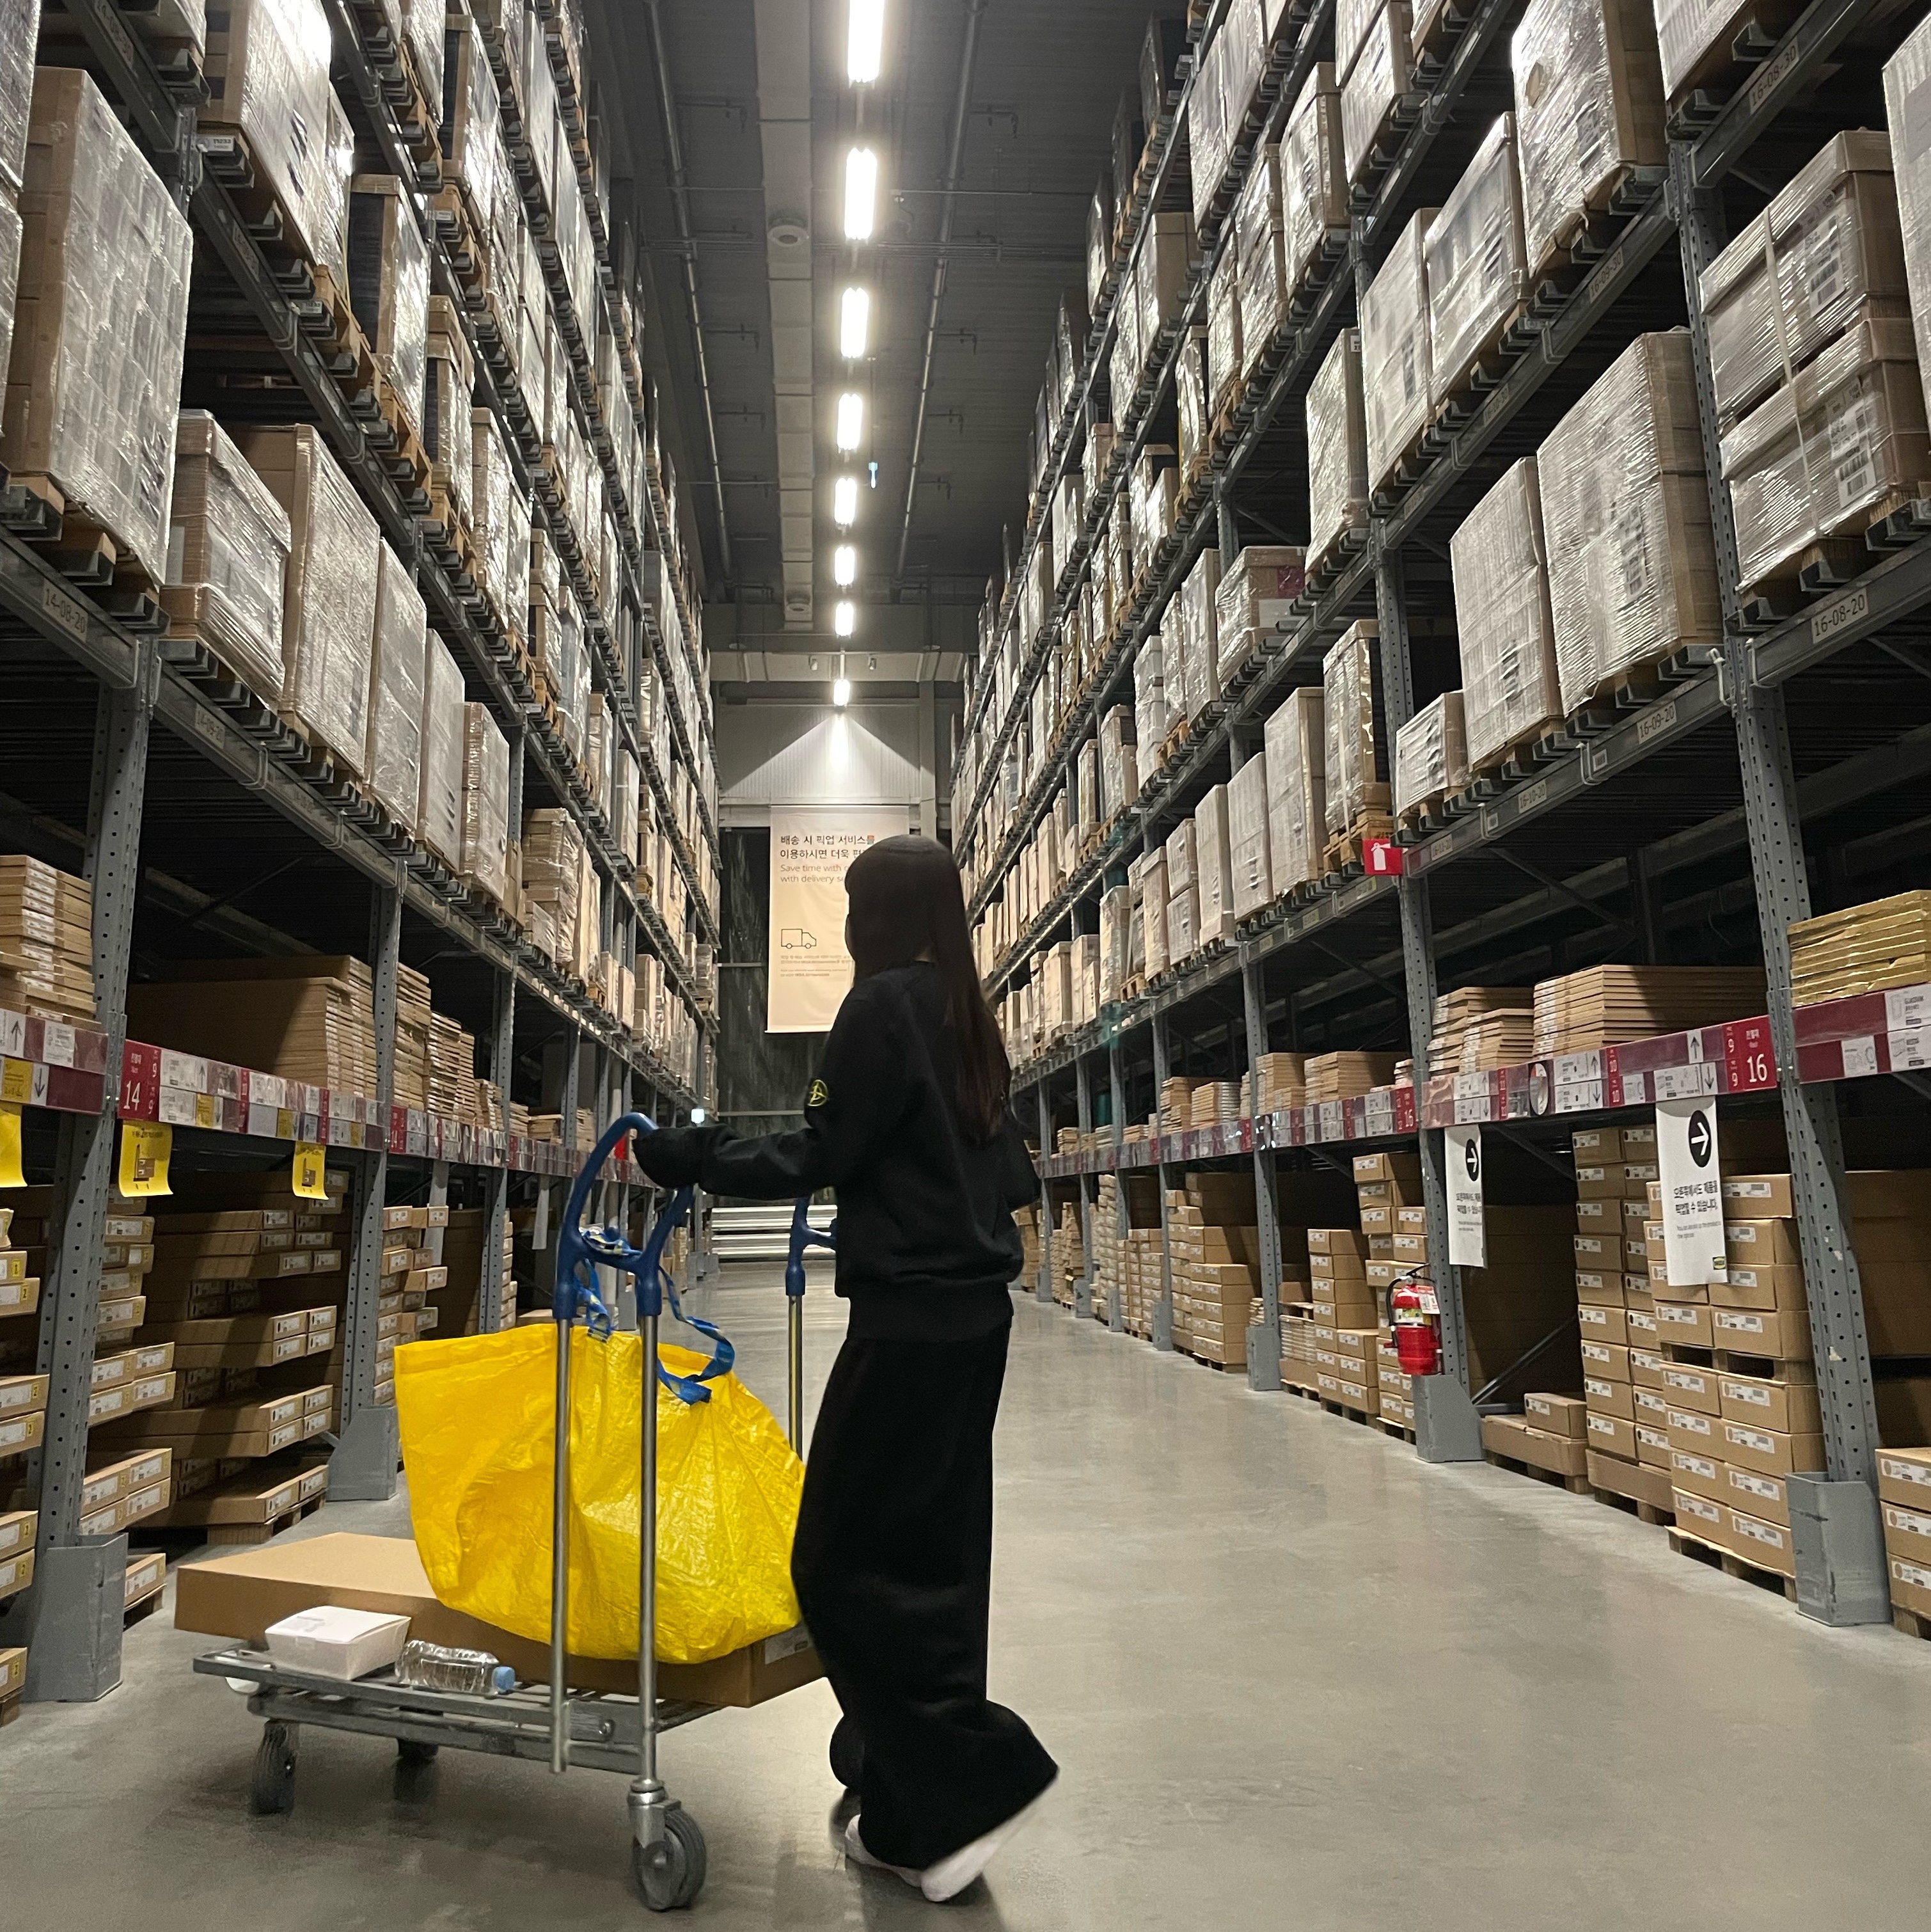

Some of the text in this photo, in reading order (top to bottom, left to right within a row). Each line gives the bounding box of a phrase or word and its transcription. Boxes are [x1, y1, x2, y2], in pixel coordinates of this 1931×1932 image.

[1752, 45, 1797, 107] 16-08-30
[45, 588, 86, 634] 14-08-20
[1815, 594, 1865, 637] 16-08-20
[1639, 705, 1675, 738] 16-09-20
[780, 835, 800, 845] 배송
[803, 835, 812, 845] 시
[816, 835, 835, 845] 픽업
[780, 849, 827, 859] 이용하시면
[832, 849, 849, 859] 더욱
[824, 864, 842, 872] with
[801, 875, 834, 884] delivery
[1728, 1038, 1768, 1083] 9 16
[123, 1079, 141, 1111] 14
[152, 1062, 157, 1078] 9
[1731, 1072, 1738, 1087] 9
[148, 1100, 154, 1115] 9
[1404, 1109, 1414, 1127] 16
